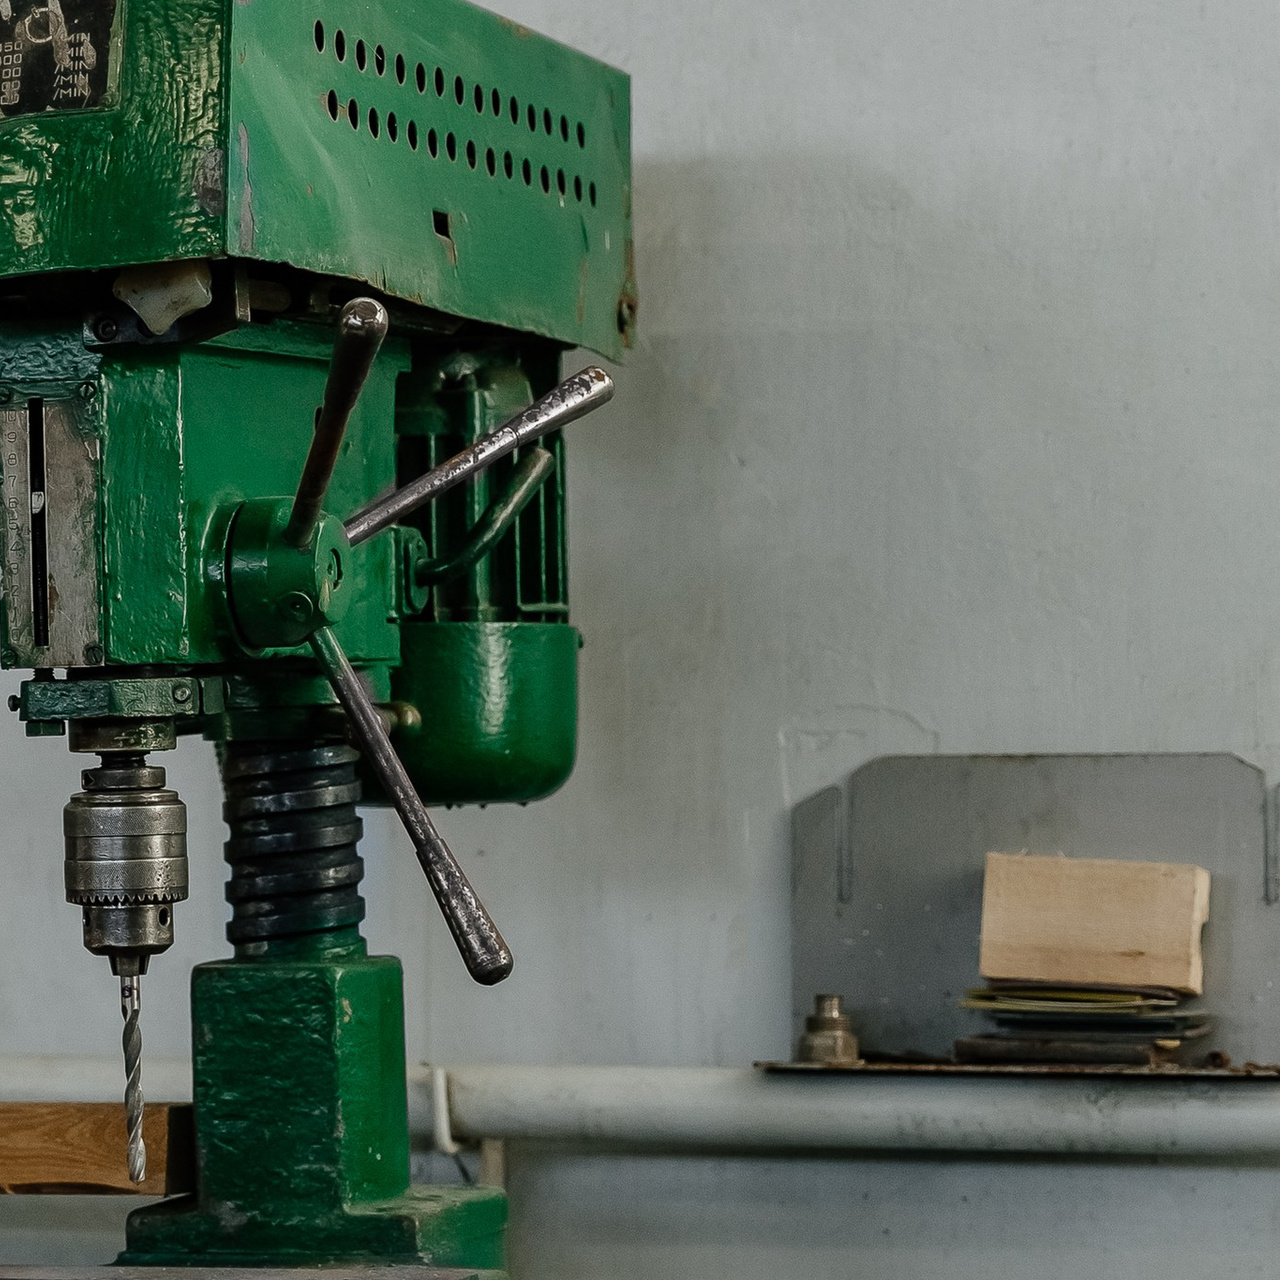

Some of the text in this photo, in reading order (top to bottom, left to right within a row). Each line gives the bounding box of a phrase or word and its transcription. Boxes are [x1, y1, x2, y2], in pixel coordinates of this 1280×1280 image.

[53, 87, 89, 100] /MIN
[7, 453, 18, 466] 8
[7, 475, 17, 488] 7
[8, 497, 19, 509] 6
[8, 518, 19, 531] 5
[11, 584, 19, 597] 2
